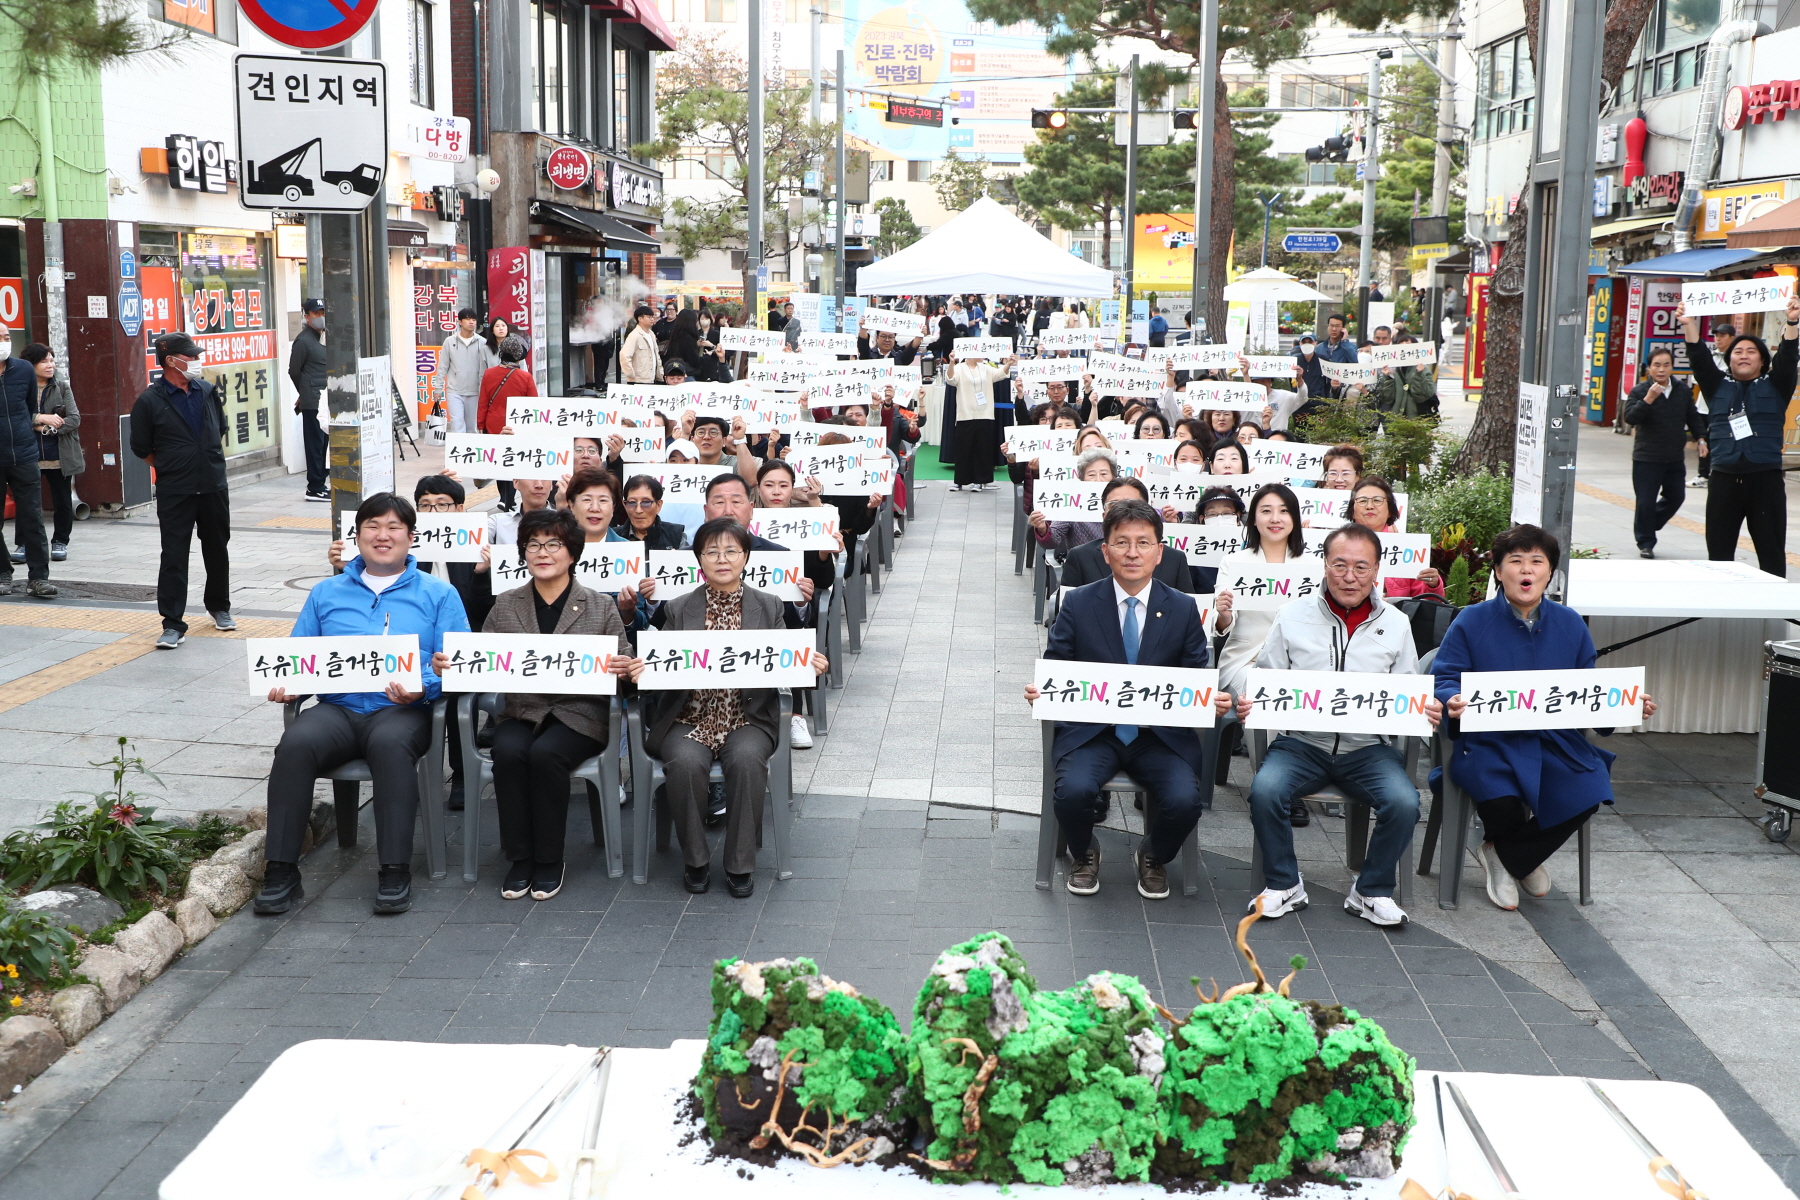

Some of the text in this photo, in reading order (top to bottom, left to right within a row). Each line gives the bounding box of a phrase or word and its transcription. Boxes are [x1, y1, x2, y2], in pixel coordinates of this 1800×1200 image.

[864, 31, 886, 40] 2023
[864, 43, 936, 61] 진로·진학
[875, 65, 922, 84] 박람회
[247, 71, 378, 107] 견인지역
[433, 116, 456, 128] 강북
[426, 128, 462, 152] 다방
[168, 134, 228, 194] 한일
[550, 162, 585, 180] 피냉면
[414, 285, 458, 306] 강북
[508, 252, 530, 331] 피냉면
[123, 298, 138, 318] ADT
[415, 309, 459, 332] 다방
[231, 334, 268, 360] 999-0700
[1589, 287, 1610, 411] 상품권
[360, 373, 374, 396] 비전
[361, 397, 382, 421] 선포식
[509, 408, 552, 427] 수유IN,
[1520, 398, 1533, 420] 비전
[1518, 423, 1537, 448] 선포식
[449, 446, 497, 465] 수유IN,
[1037, 492, 1082, 509] 수유IN,
[656, 565, 707, 585] 수유IN
[1233, 576, 1291, 598] 수유IN,
[254, 654, 320, 678] 수유IN,
[450, 649, 515, 675] 수유IN,
[644, 647, 713, 673] 수유IN,
[1040, 677, 1110, 706] 수유IN,
[1253, 686, 1323, 714] 수유IN,
[1467, 689, 1537, 714] 수유IN,
